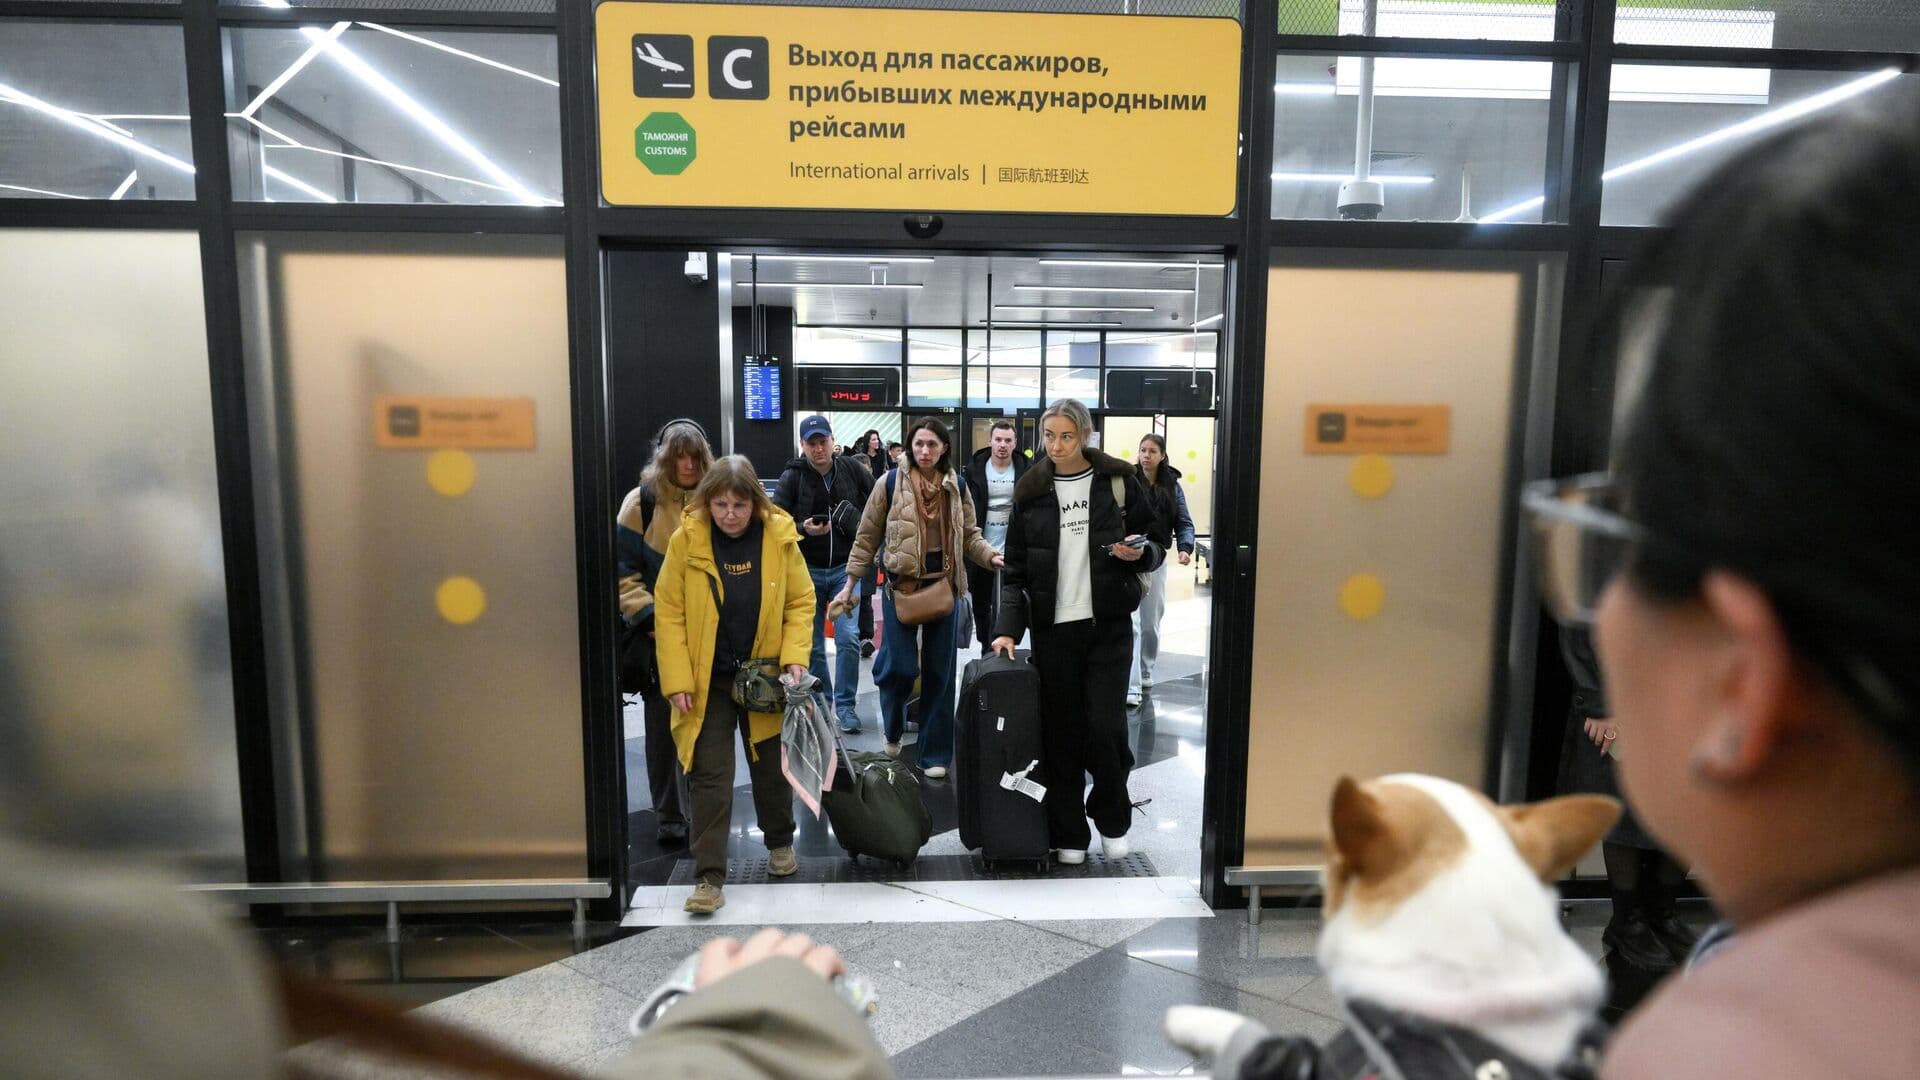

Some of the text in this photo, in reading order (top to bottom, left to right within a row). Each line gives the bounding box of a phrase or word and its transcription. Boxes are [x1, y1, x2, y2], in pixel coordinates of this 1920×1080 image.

[722, 48, 753, 90] C
[788, 43, 1110, 77] Выход для пассажиров,
[788, 79, 1208, 115] прибывших международными
[642, 131, 689, 142] ТАМОЖНЯ
[789, 115, 906, 143] рейсами
[644, 145, 688, 156] CUSTOMS
[789, 161, 970, 181] International arrivals
[998, 167, 1090, 185] 国际航班到达
